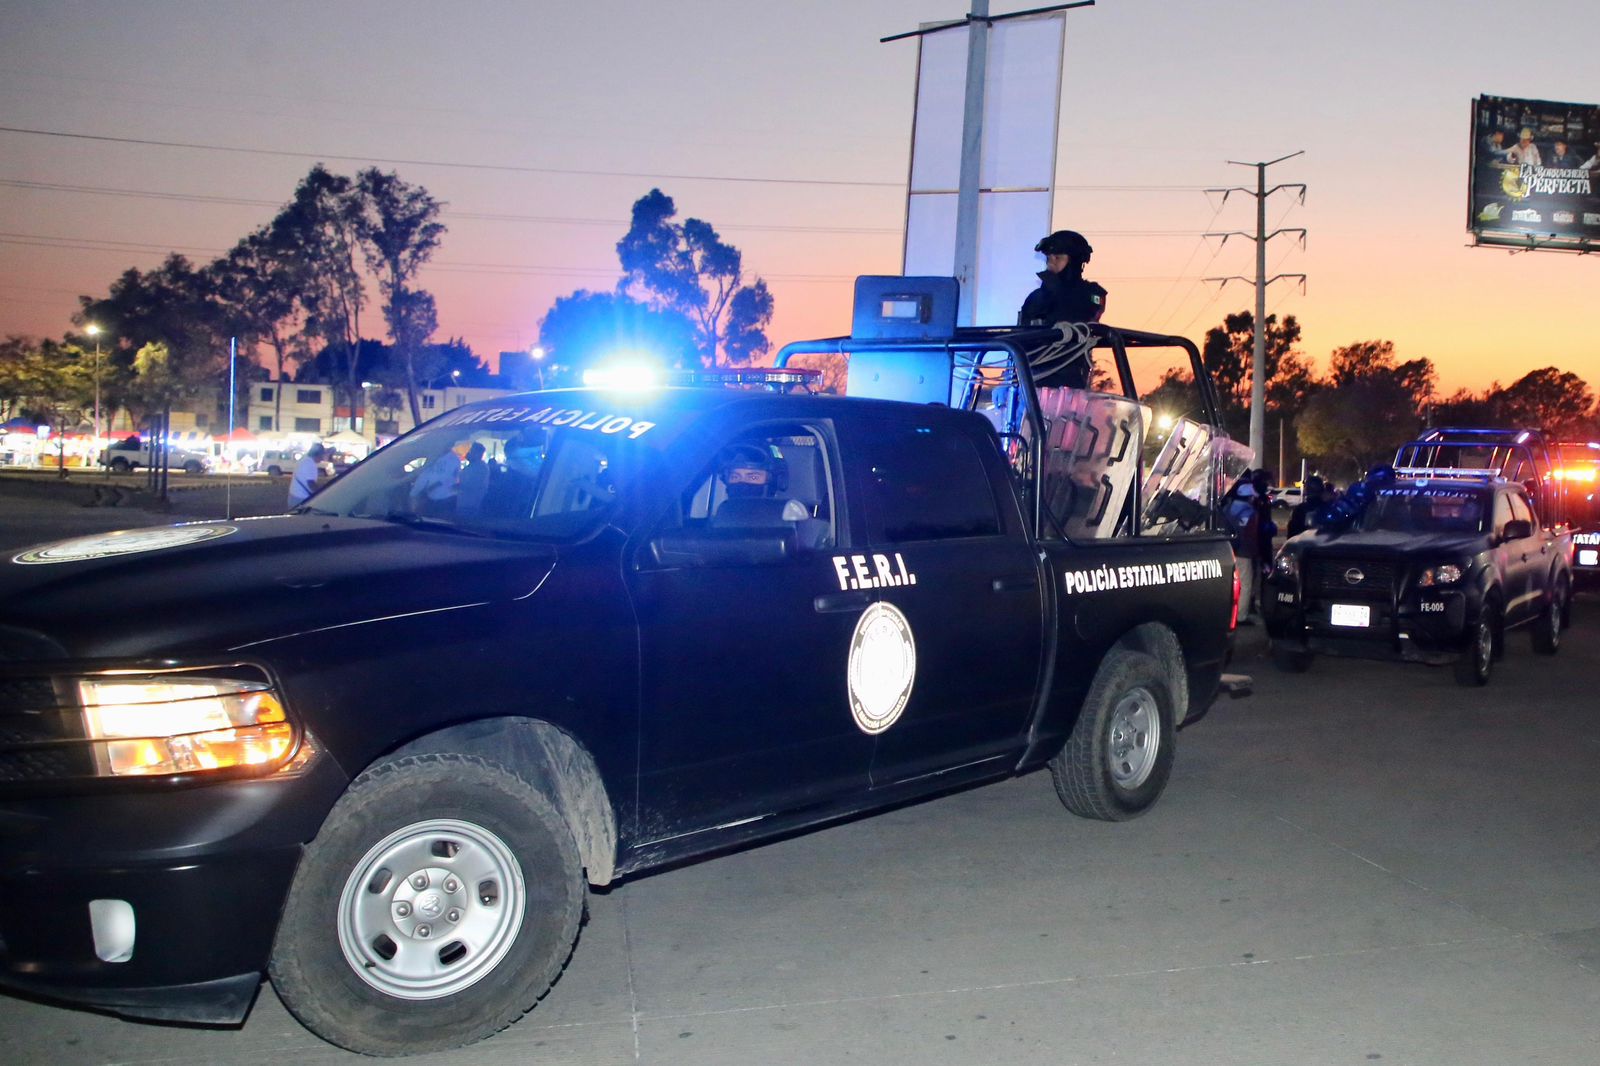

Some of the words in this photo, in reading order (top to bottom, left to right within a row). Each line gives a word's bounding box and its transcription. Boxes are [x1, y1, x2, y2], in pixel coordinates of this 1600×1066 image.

[1519, 163, 1533, 178] LA
[1522, 174, 1592, 198] PERFECTA
[832, 553, 917, 591] F.E.R.I.
[1065, 563, 1118, 595] POLICÍA
[1118, 564, 1166, 589] ESTATAL
[1166, 559, 1223, 584] PREVENTIVA
[1420, 603, 1445, 612] FE-005
